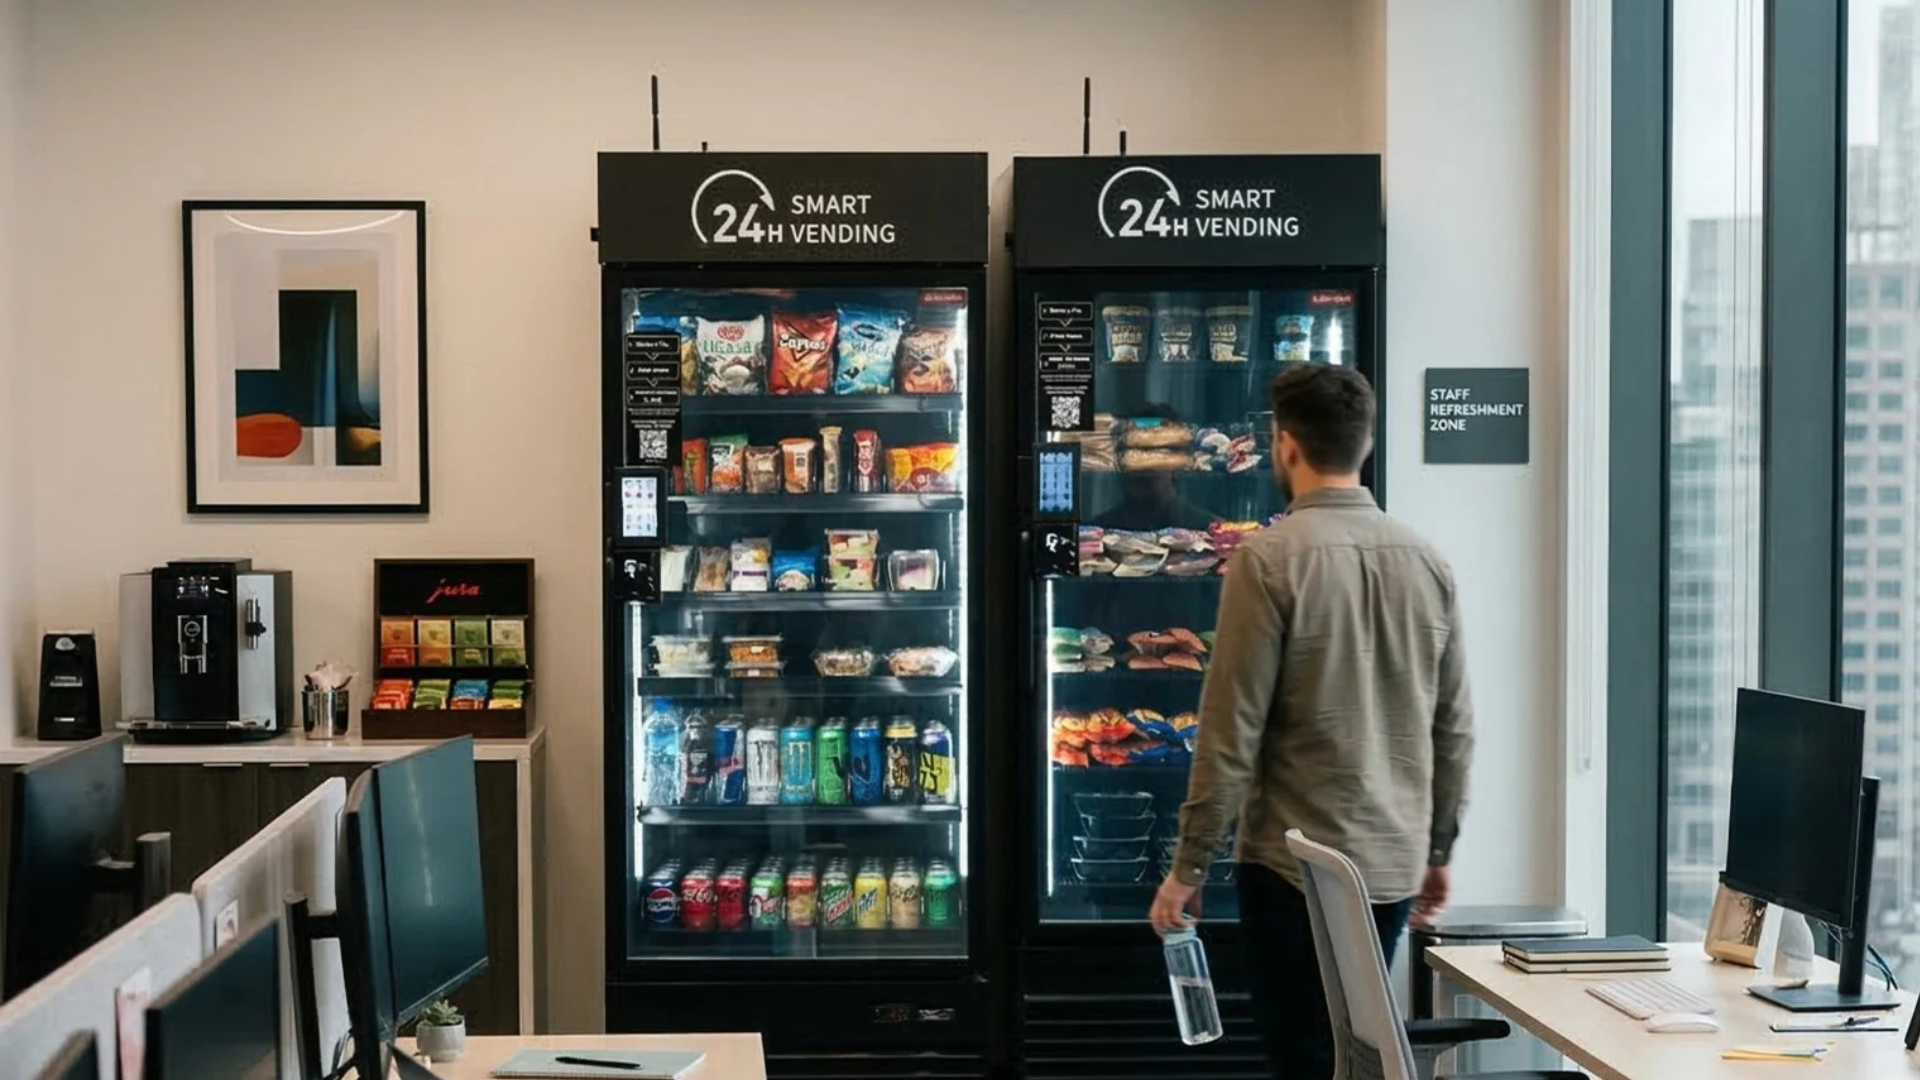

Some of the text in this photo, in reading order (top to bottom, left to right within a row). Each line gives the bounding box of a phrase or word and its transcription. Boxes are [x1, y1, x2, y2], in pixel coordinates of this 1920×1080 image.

[791, 194, 872, 215] SMART
[1195, 189, 1276, 209] SMART
[713, 203, 896, 244] 24H VENDING
[1118, 198, 1299, 237] 24H VENDING
[1430, 388, 1471, 401] STAFF
[1430, 403, 1524, 416] REFRESHMENT
[1430, 418, 1467, 431] ZONE
[426, 578, 480, 604] jura
